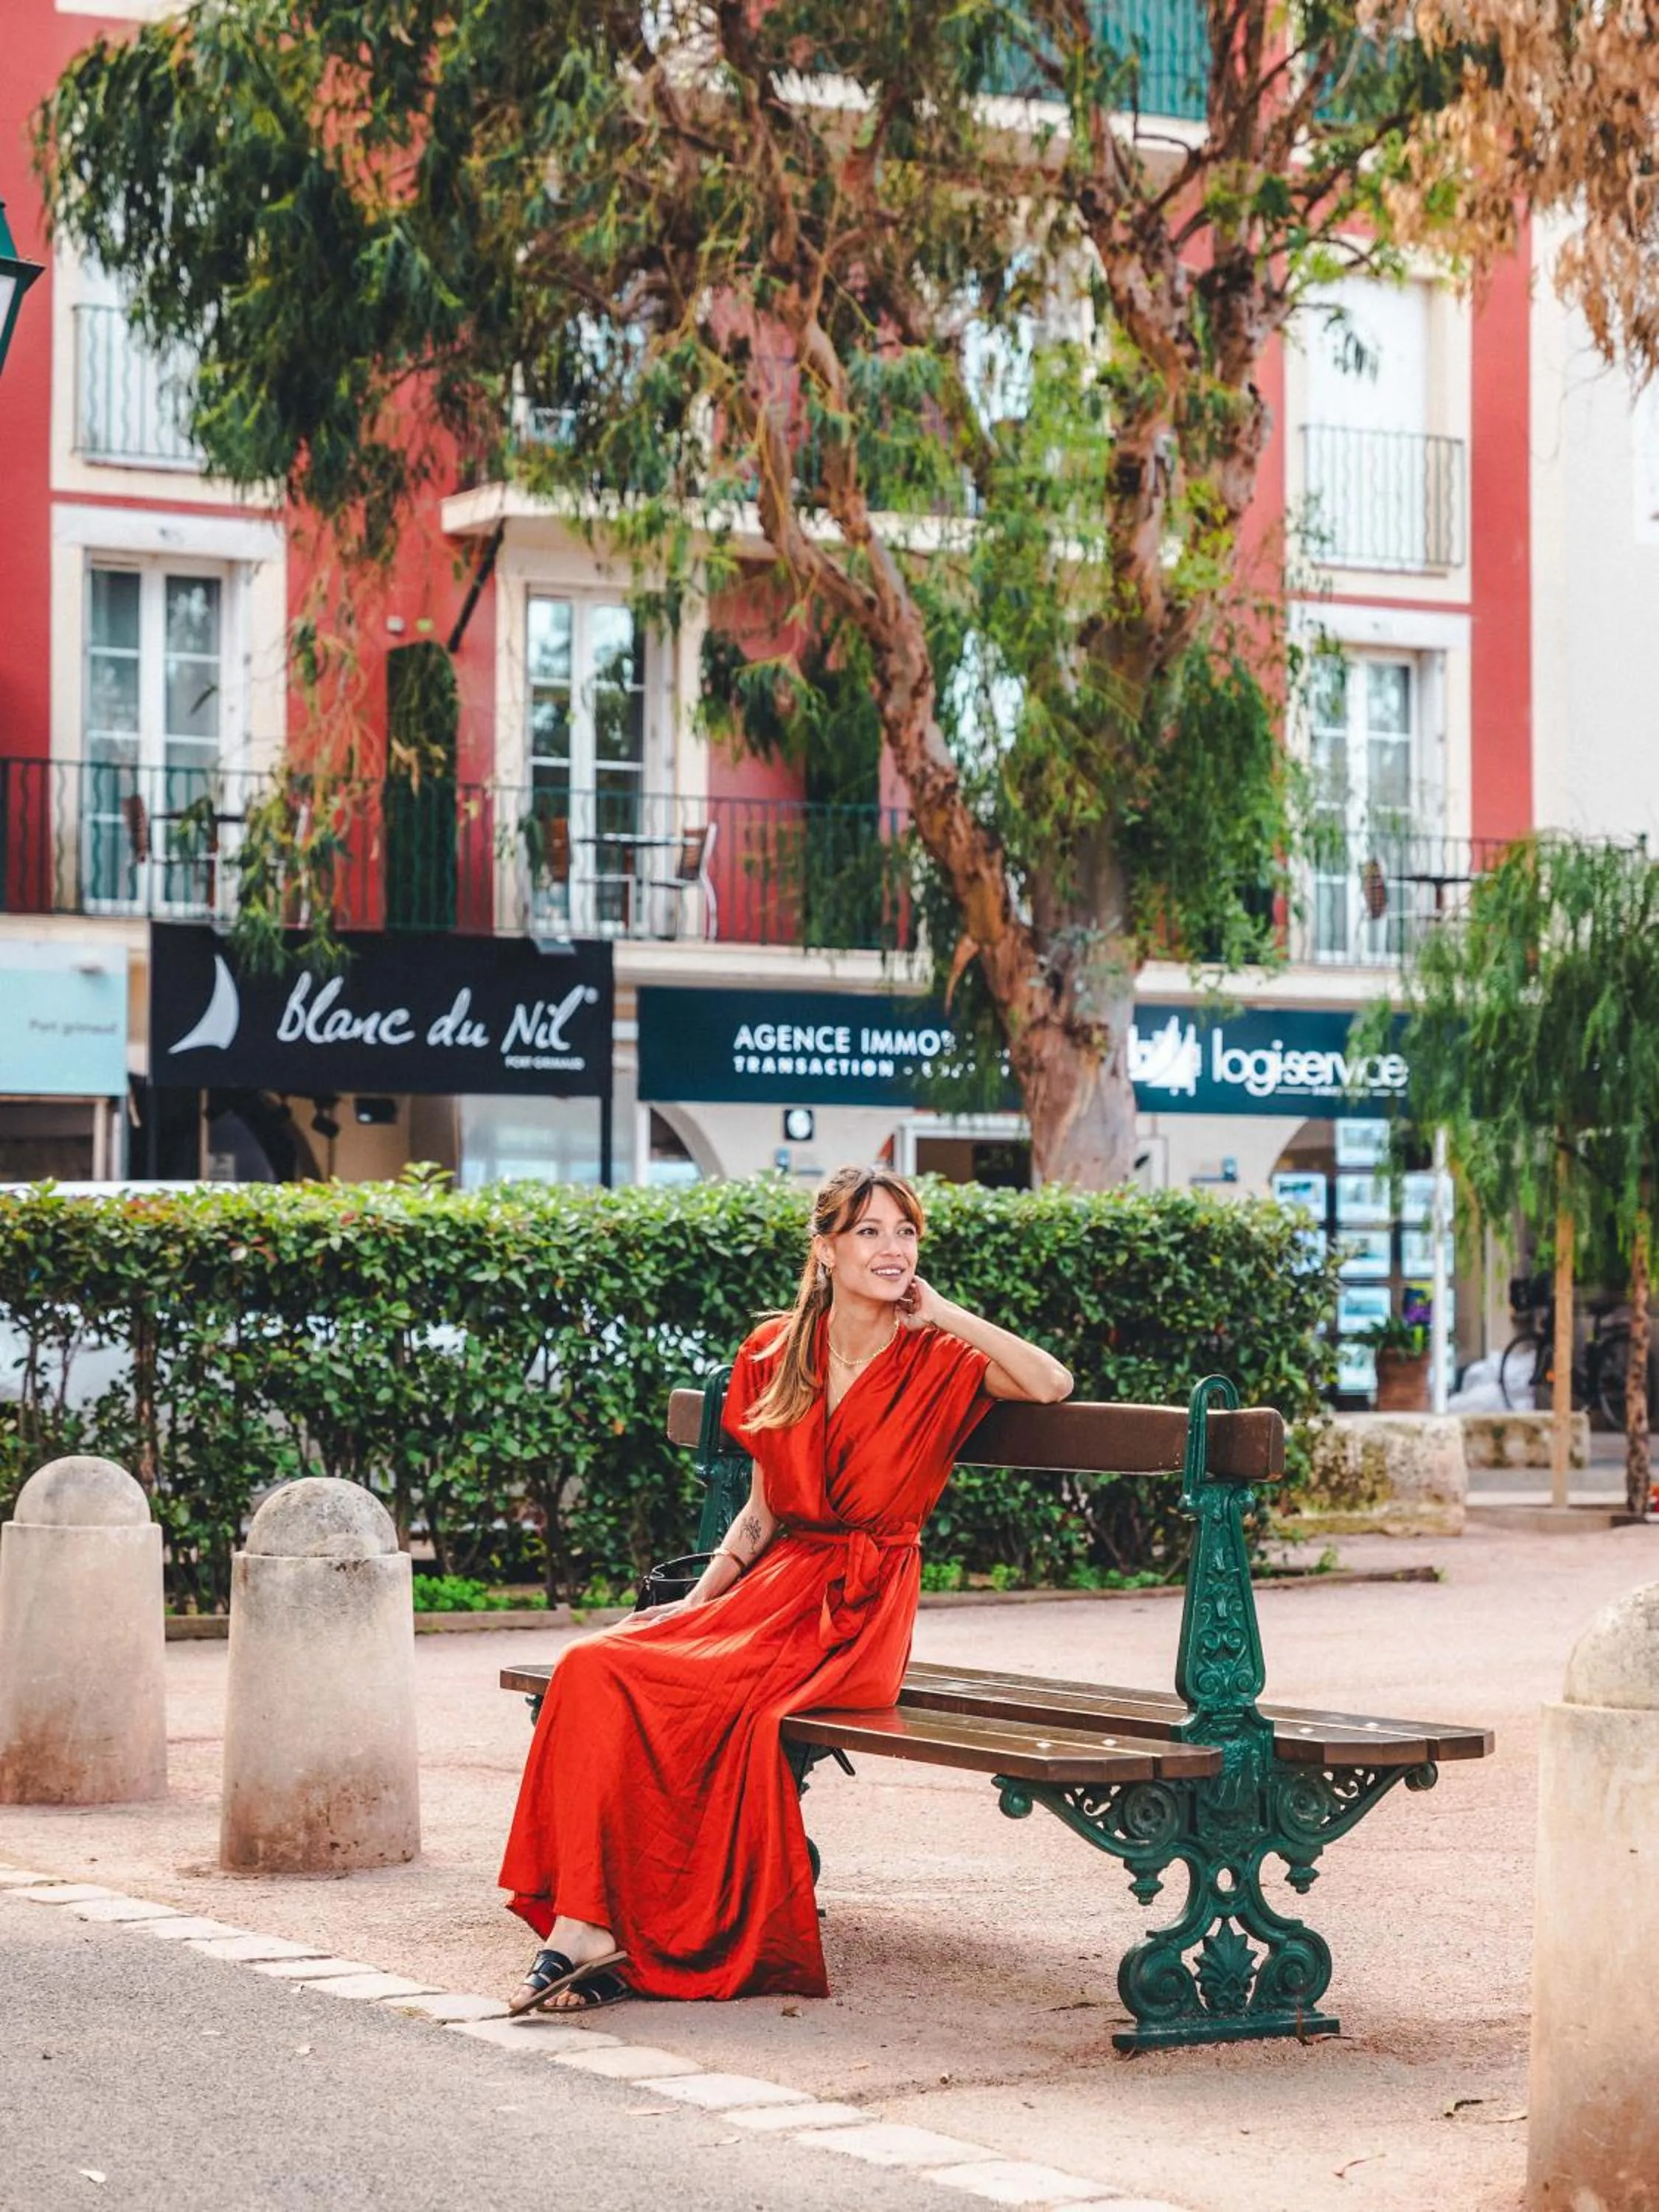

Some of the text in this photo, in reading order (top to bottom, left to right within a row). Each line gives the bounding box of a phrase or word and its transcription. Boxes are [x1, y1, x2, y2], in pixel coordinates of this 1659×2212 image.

[276, 970, 415, 1045] Blanc
[426, 987, 489, 1048] du
[733, 1023, 850, 1054] AGENCE
[733, 1055, 894, 1077] TRANSACTION
